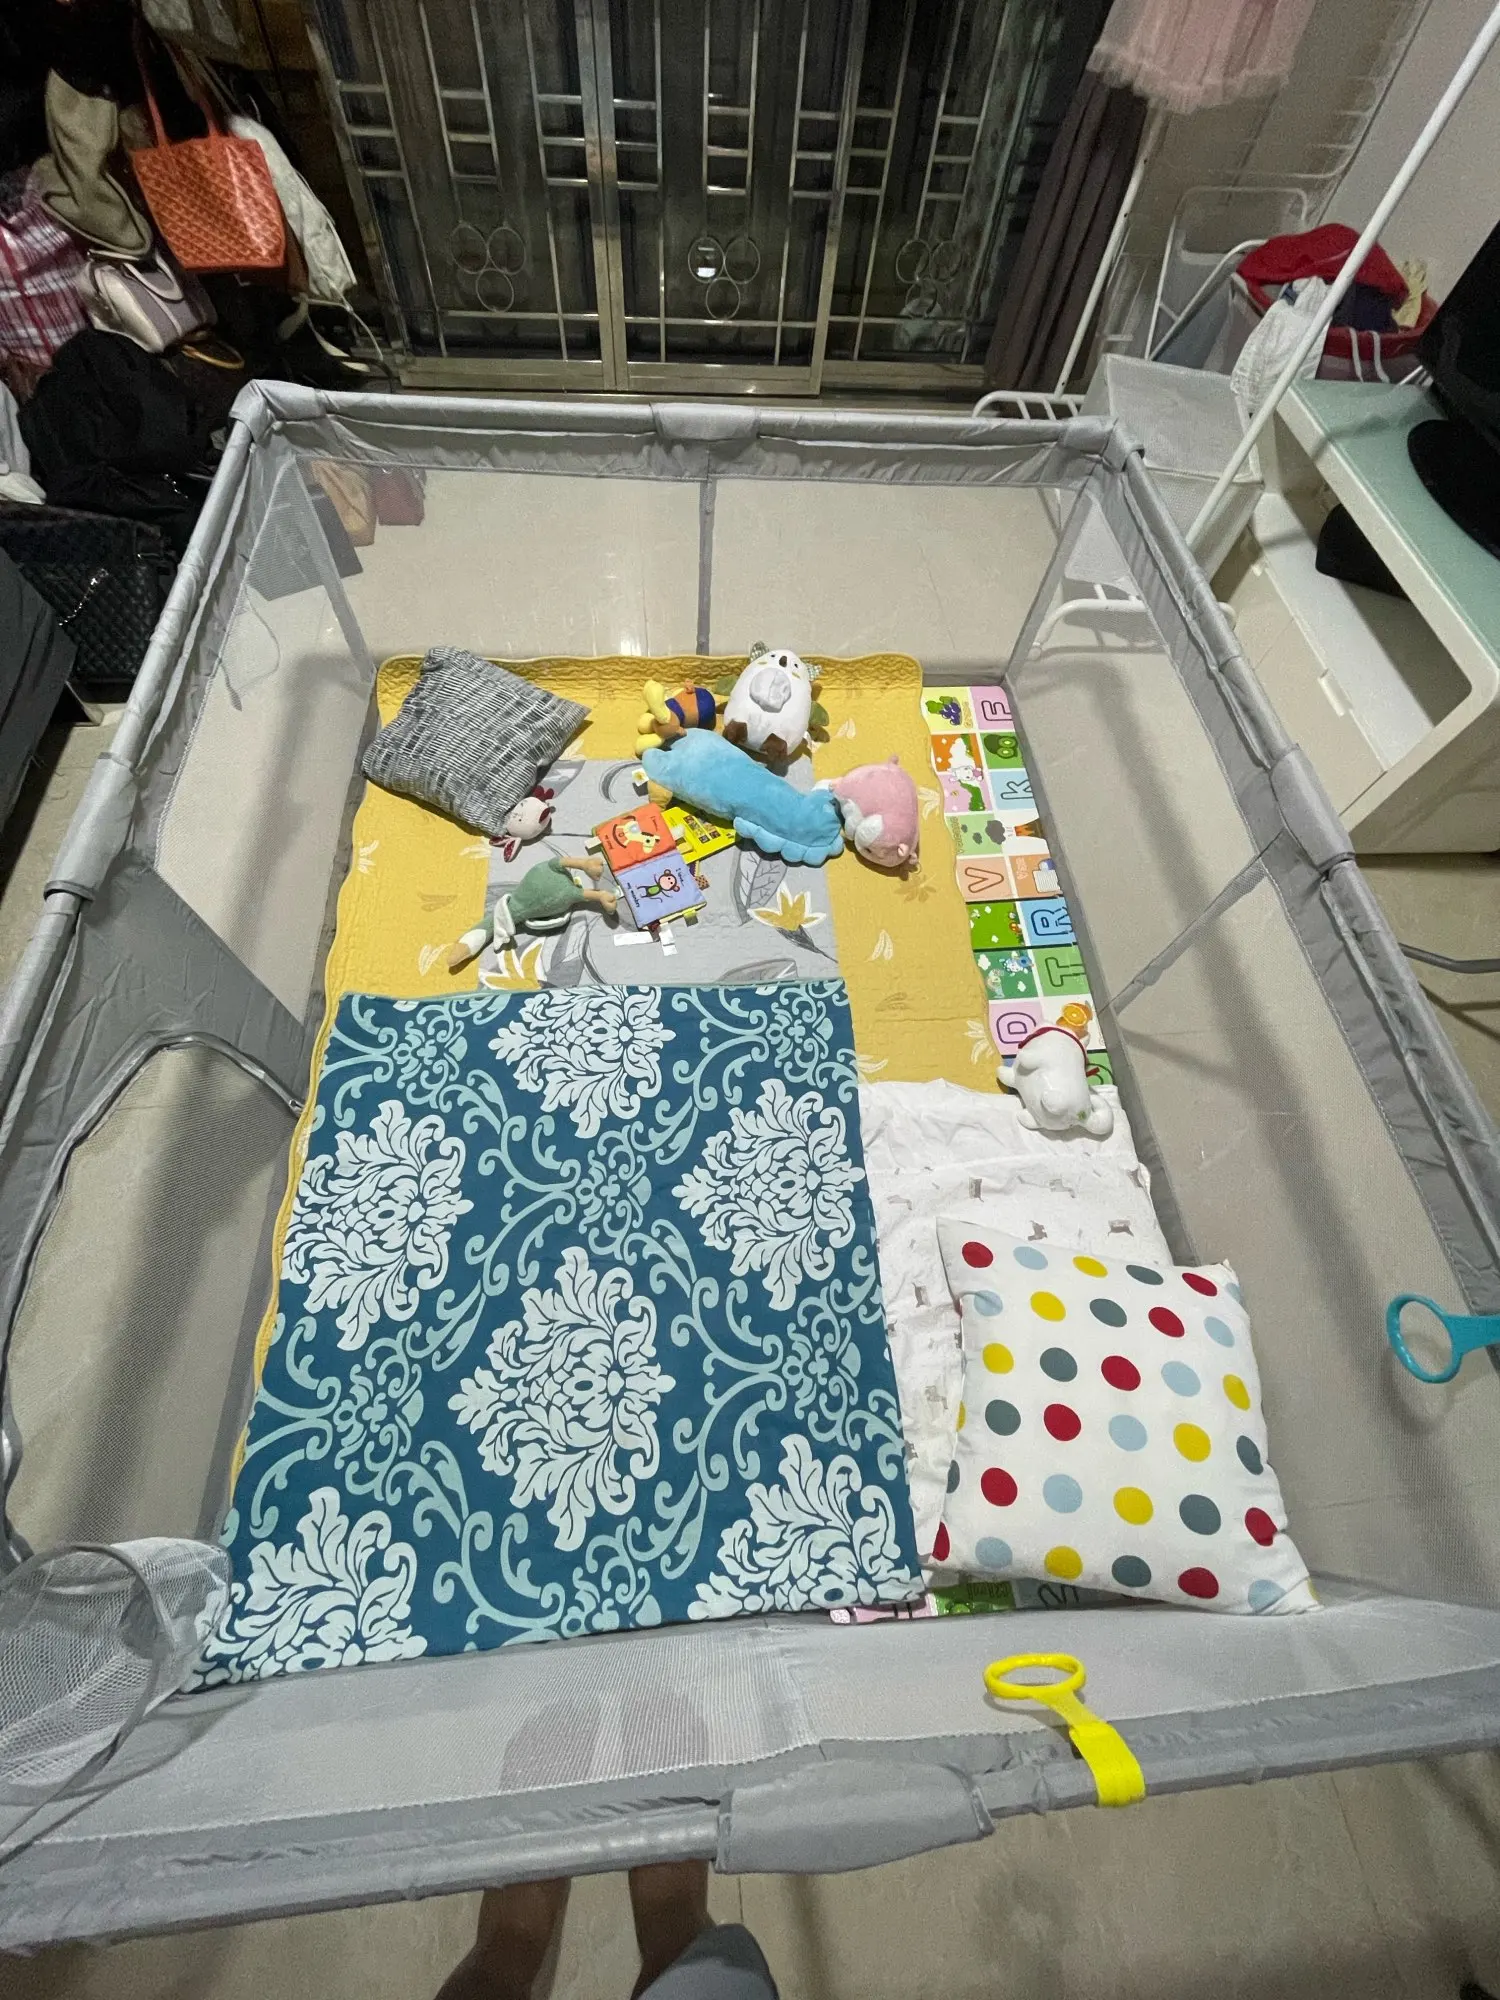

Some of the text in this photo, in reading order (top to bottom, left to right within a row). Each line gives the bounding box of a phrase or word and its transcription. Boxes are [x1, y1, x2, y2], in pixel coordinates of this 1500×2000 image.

[965, 866, 1004, 893] V
[1031, 906, 1074, 937] R
[1045, 956, 1086, 987] T
[996, 1011, 1037, 1044] D
